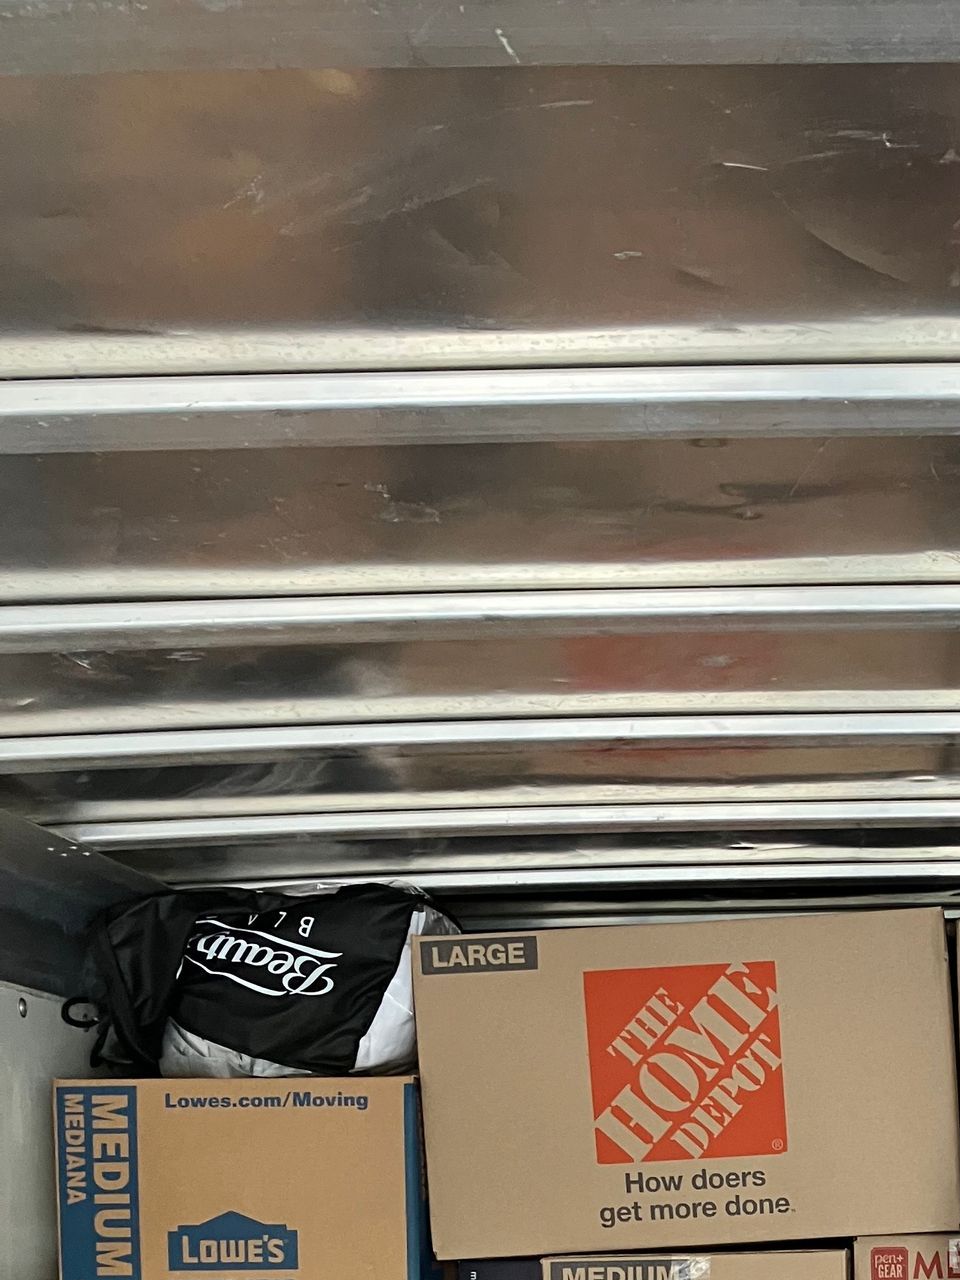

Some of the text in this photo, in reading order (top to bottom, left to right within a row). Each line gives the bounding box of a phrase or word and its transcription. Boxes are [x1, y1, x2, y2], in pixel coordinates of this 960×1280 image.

[432, 942, 526, 968] LARGE
[606, 986, 685, 1067] THE
[594, 961, 780, 1163] HOME
[164, 1090, 369, 1111] Lowes.com/Moving
[670, 1032, 783, 1160] DEPOT
[64, 1093, 87, 1206] MEDIANA
[91, 1094, 133, 1277] MEDIUM
[624, 1167, 766, 1193] How doers
[599, 1202, 643, 1228] get
[650, 1200, 717, 1222] more
[182, 1235, 285, 1264] LOWE'S
[873, 1253, 905, 1268] pen+
[878, 1264, 904, 1279] GEAR
